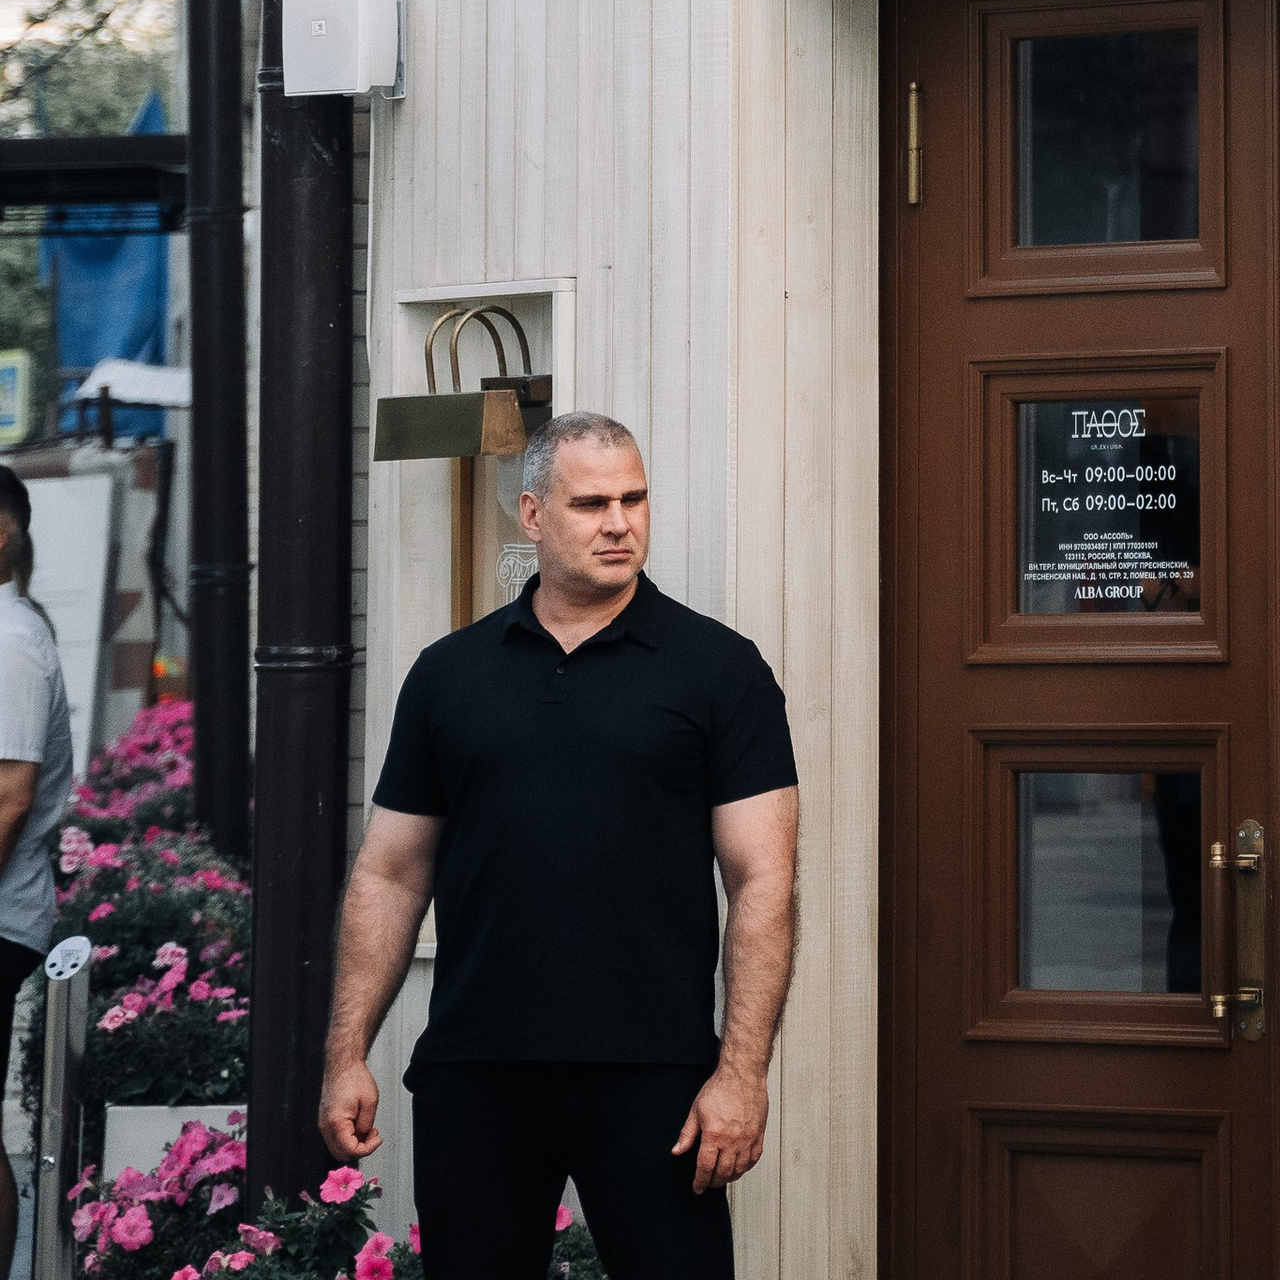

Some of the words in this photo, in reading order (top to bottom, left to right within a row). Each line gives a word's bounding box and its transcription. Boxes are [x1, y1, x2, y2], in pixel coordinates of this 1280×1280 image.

[1041, 498, 1058, 513] Пт,
[1062, 497, 1080, 512] Сб
[1083, 532, 1098, 540] ООО
[1058, 543, 1072, 551] ИНН
[1112, 542, 1126, 550] КПП
[1127, 541, 1158, 550] 770301001
[1123, 551, 1153, 560] МОСКВА,
[1057, 561, 1117, 571] МУНИЦИПАЛЬНЫЙ
[1118, 561, 1139, 570] ОКРУГ
[1024, 573, 1071, 581] ПРЕСНЕНСКАЯ
[1074, 586, 1103, 599] ALBA
[1104, 585, 1144, 599] GROUP
